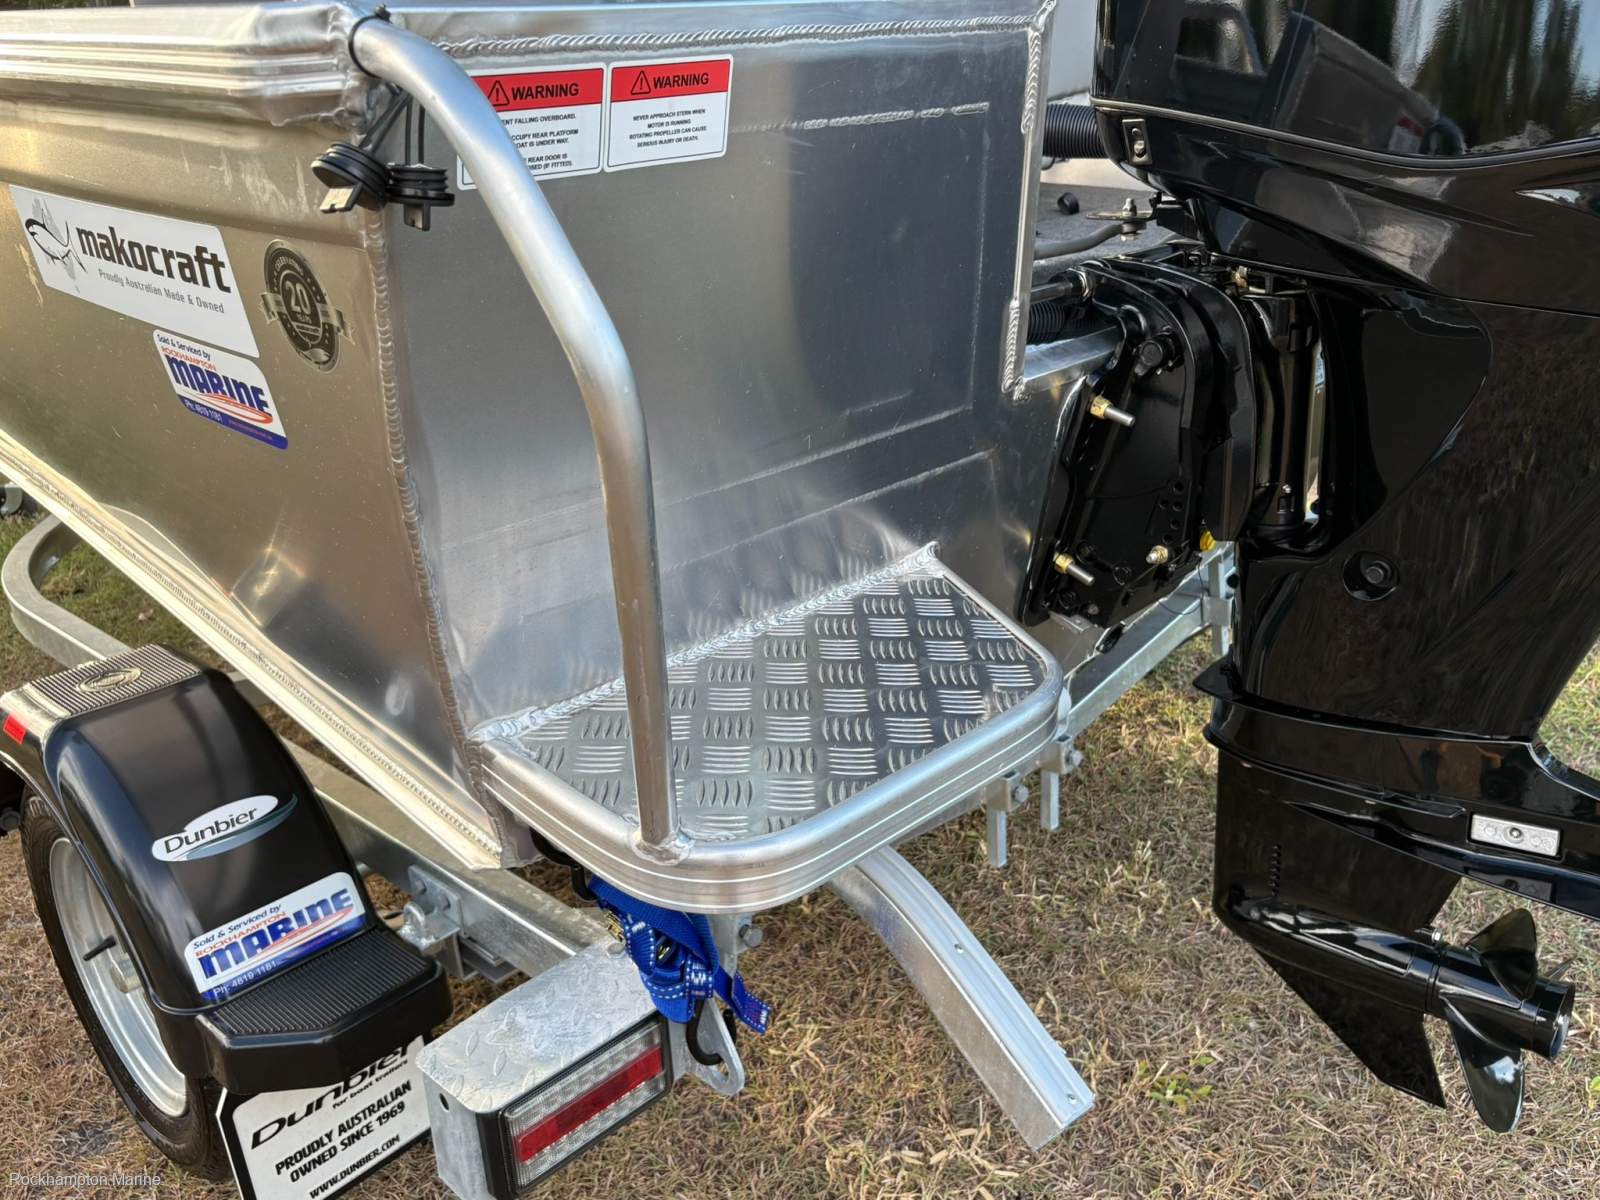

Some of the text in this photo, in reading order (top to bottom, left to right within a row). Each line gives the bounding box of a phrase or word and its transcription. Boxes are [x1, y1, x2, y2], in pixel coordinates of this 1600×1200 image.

[512, 82, 579, 100] WARNING
[653, 72, 709, 89] WARNING
[514, 116, 539, 124] FALLING
[650, 111, 675, 120] APPROACH
[512, 134, 532, 142] CCUPY
[549, 128, 579, 137] PLATFORM
[536, 138, 556, 146] UNDER
[629, 132, 653, 140] ROTATING
[654, 129, 681, 138] PROPELLER
[637, 140, 658, 148] SERIOUS
[76, 226, 232, 293] makocraft
[98, 268, 225, 314] Proudly Australian Made & Owned
[285, 280, 311, 315] 20
[176, 341, 202, 358] Serviced
[202, 350, 211, 361] by
[164, 807, 257, 854] Dunbier
[193, 904, 282, 949] Sold & Serviced by
[195, 911, 286, 958] ROCKHAMPTON
[198, 888, 354, 979] MARINE
[350, 1081, 373, 1099] boat
[274, 1079, 412, 1176] PROUDLY AUSTRALIAN
[290, 1101, 406, 1182] OWNED SINCE 1969
[309, 1134, 400, 1199] WWW.DUNBIER.COM
